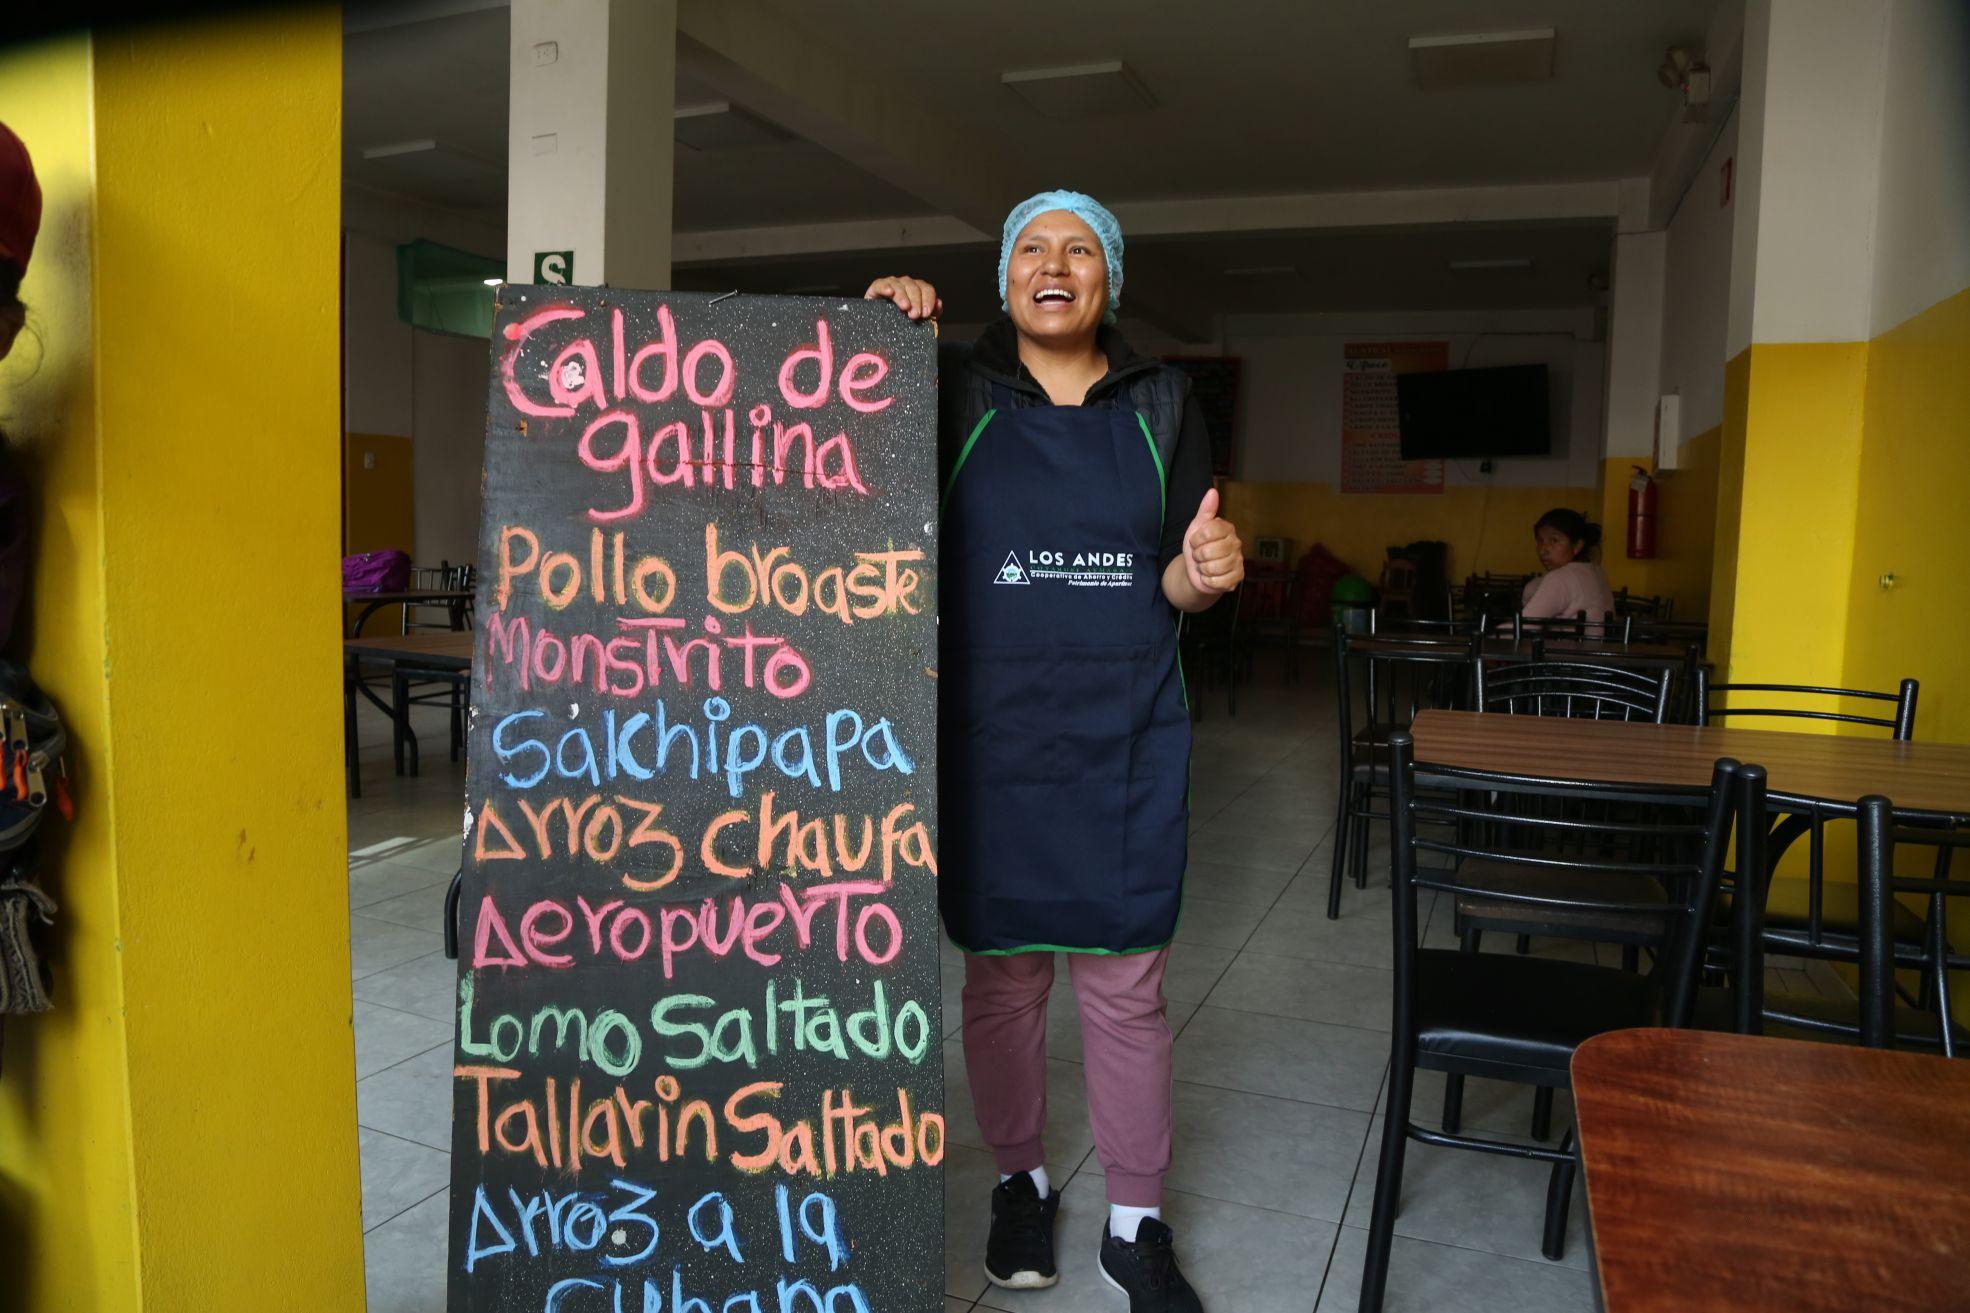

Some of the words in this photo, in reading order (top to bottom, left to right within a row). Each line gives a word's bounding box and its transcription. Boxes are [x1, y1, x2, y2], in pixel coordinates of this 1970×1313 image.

[502, 304, 736, 418] Caldo
[778, 319, 894, 413] de
[578, 404, 869, 521] gallina
[498, 523, 677, 614] Pollo
[705, 521, 926, 626] broaste
[1029, 550, 1064, 567] LOS
[1072, 552, 1134, 568] ANDES
[485, 614, 812, 700] Monstrito
[492, 696, 916, 798] Salchipapa
[474, 794, 685, 892] Arroz
[700, 790, 938, 883] chaufa
[473, 880, 904, 980] Aeropuerto
[459, 969, 643, 1077] Lomo
[651, 977, 930, 1070] Saltado
[453, 1065, 719, 1171] Tallarin
[723, 1080, 945, 1180] Saltado
[465, 1178, 660, 1274] Arroz
[687, 1191, 746, 1264] a
[774, 1182, 847, 1273] la
